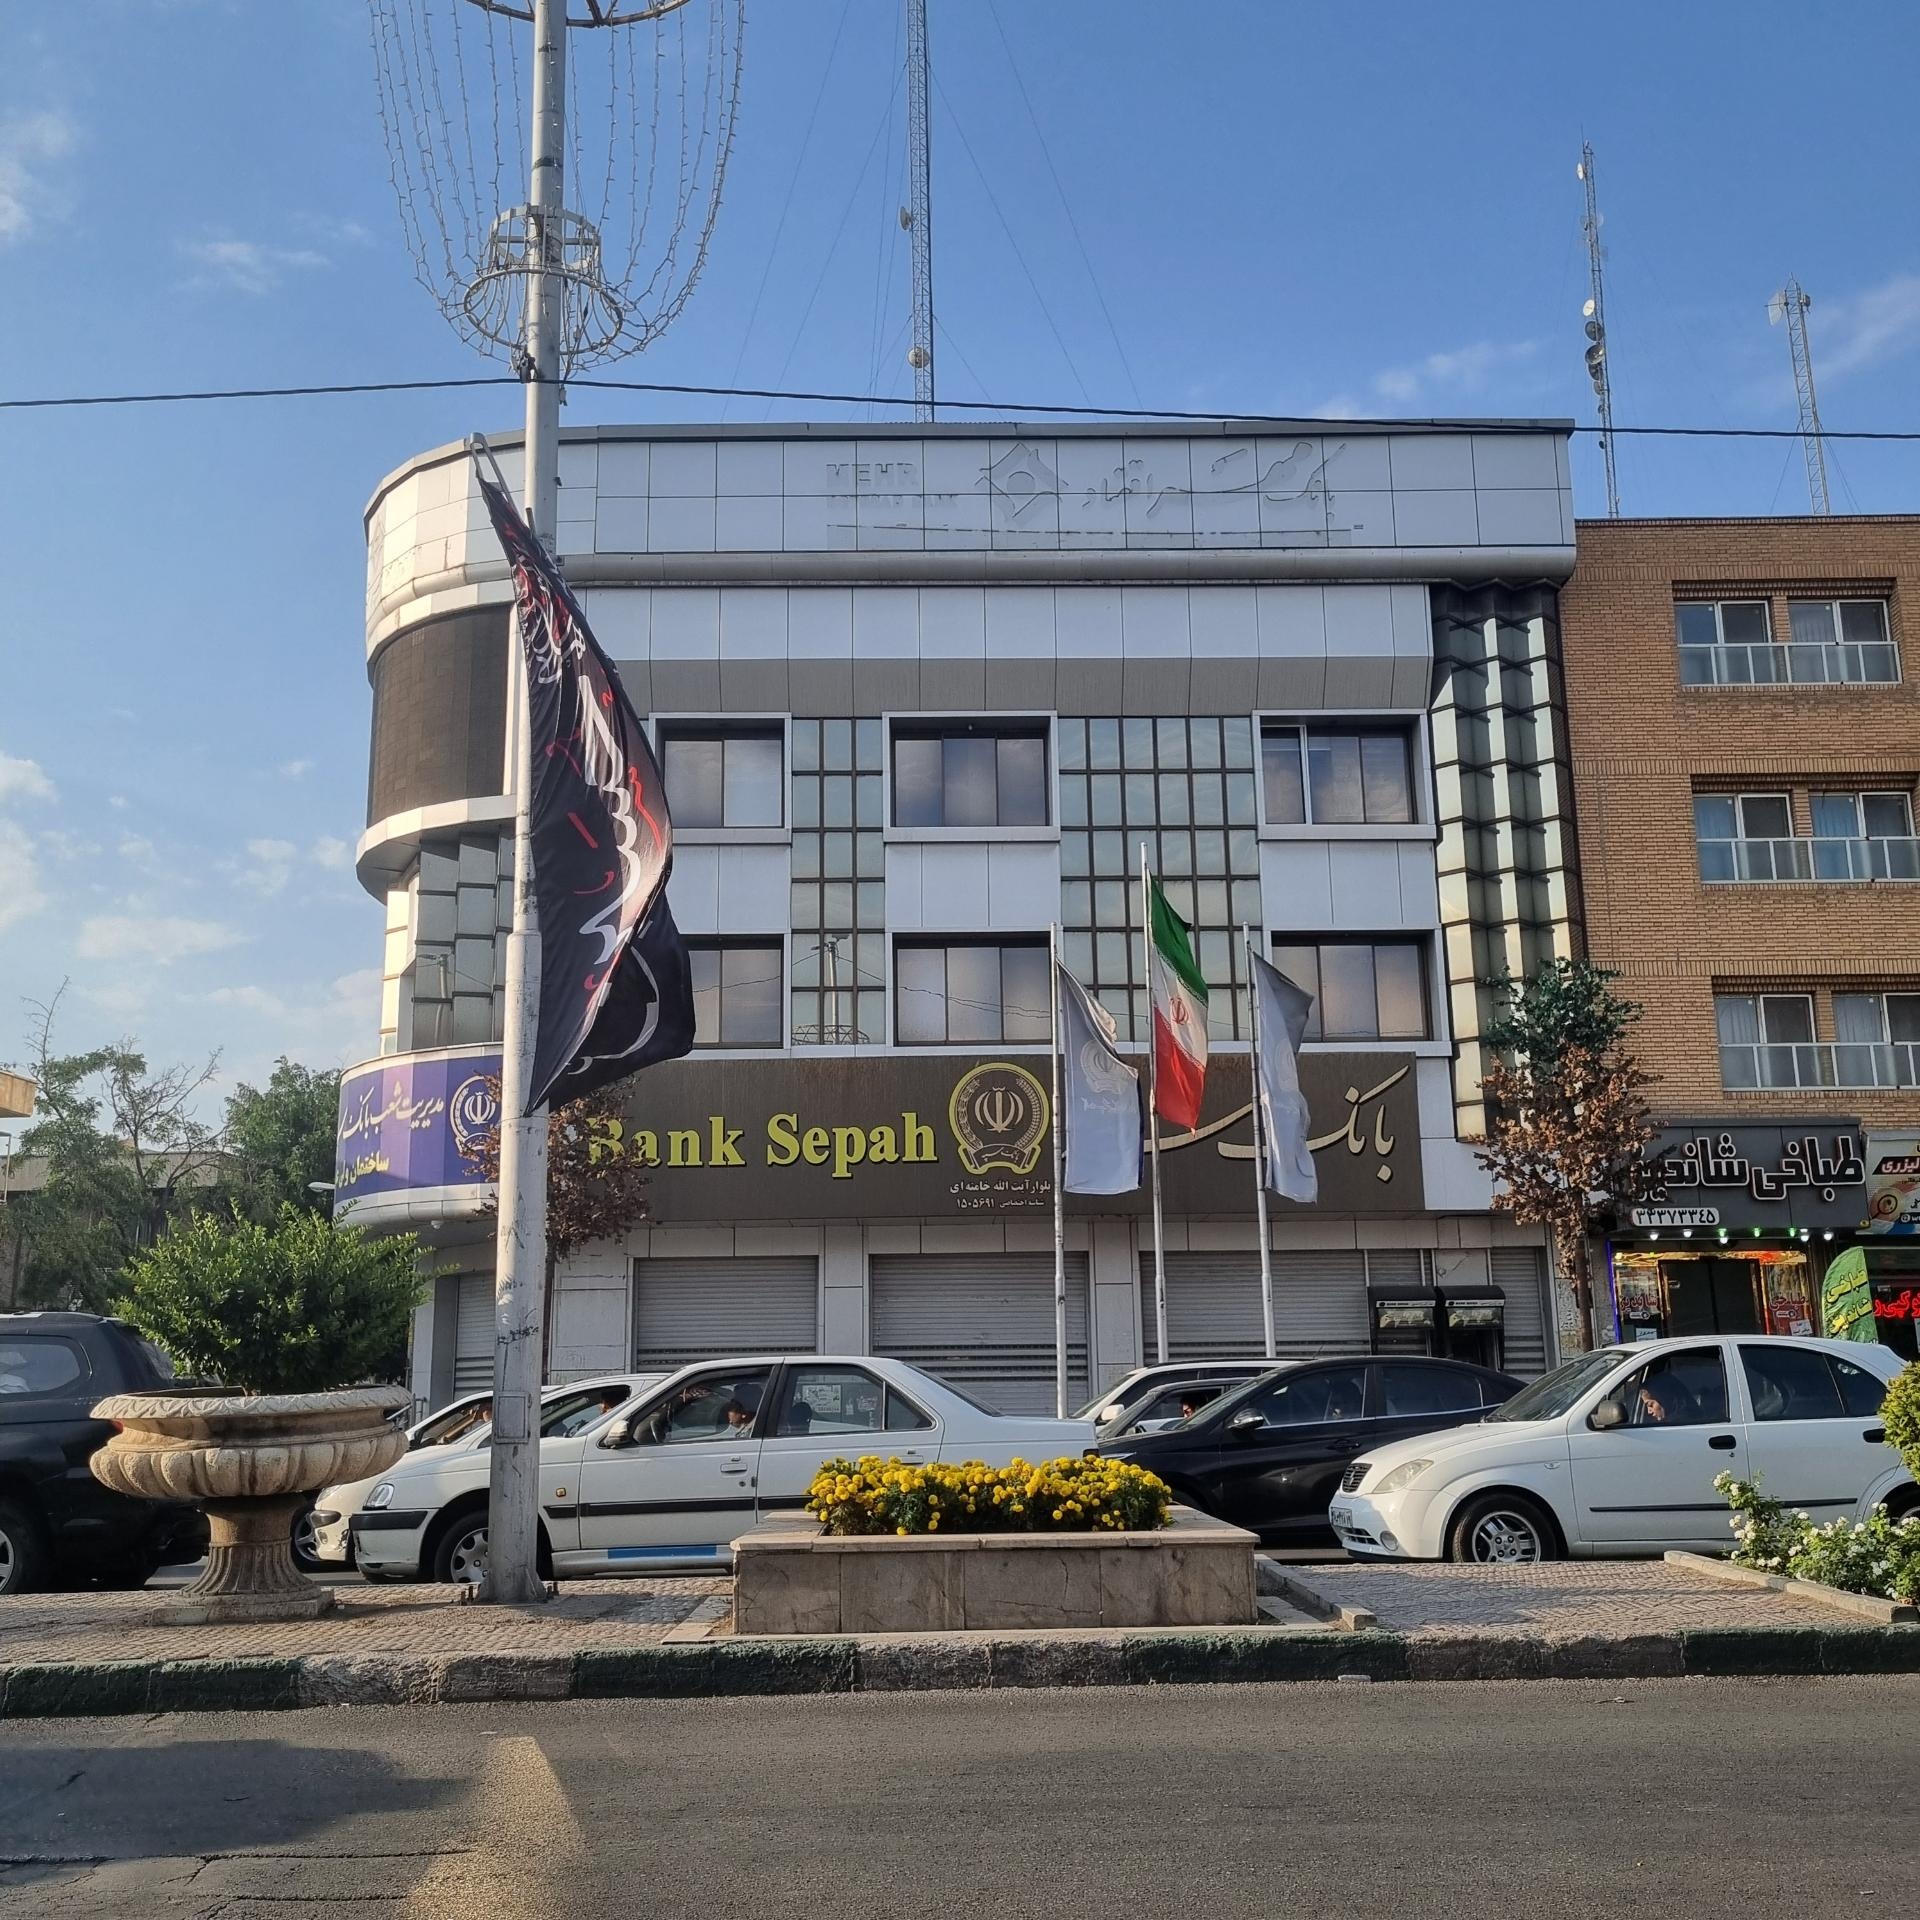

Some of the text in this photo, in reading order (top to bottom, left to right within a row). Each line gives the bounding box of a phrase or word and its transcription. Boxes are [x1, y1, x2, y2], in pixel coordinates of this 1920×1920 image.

[343, 1086, 375, 1140] بانک
[370, 1080, 402, 1135] شعب
[396, 1097, 444, 1130] مدیریت
[585, 1112, 938, 1178] Bank Sepah
[350, 1150, 390, 1184] ساختمان
[1751, 1134, 1866, 1202] طباخی
[993, 1180, 1009, 1191] الله
[1011, 1179, 1030, 1193] آیت
[1031, 1180, 1051, 1194] بلوار
[956, 1197, 995, 1209] ۱۵۰۵۶۹۱
